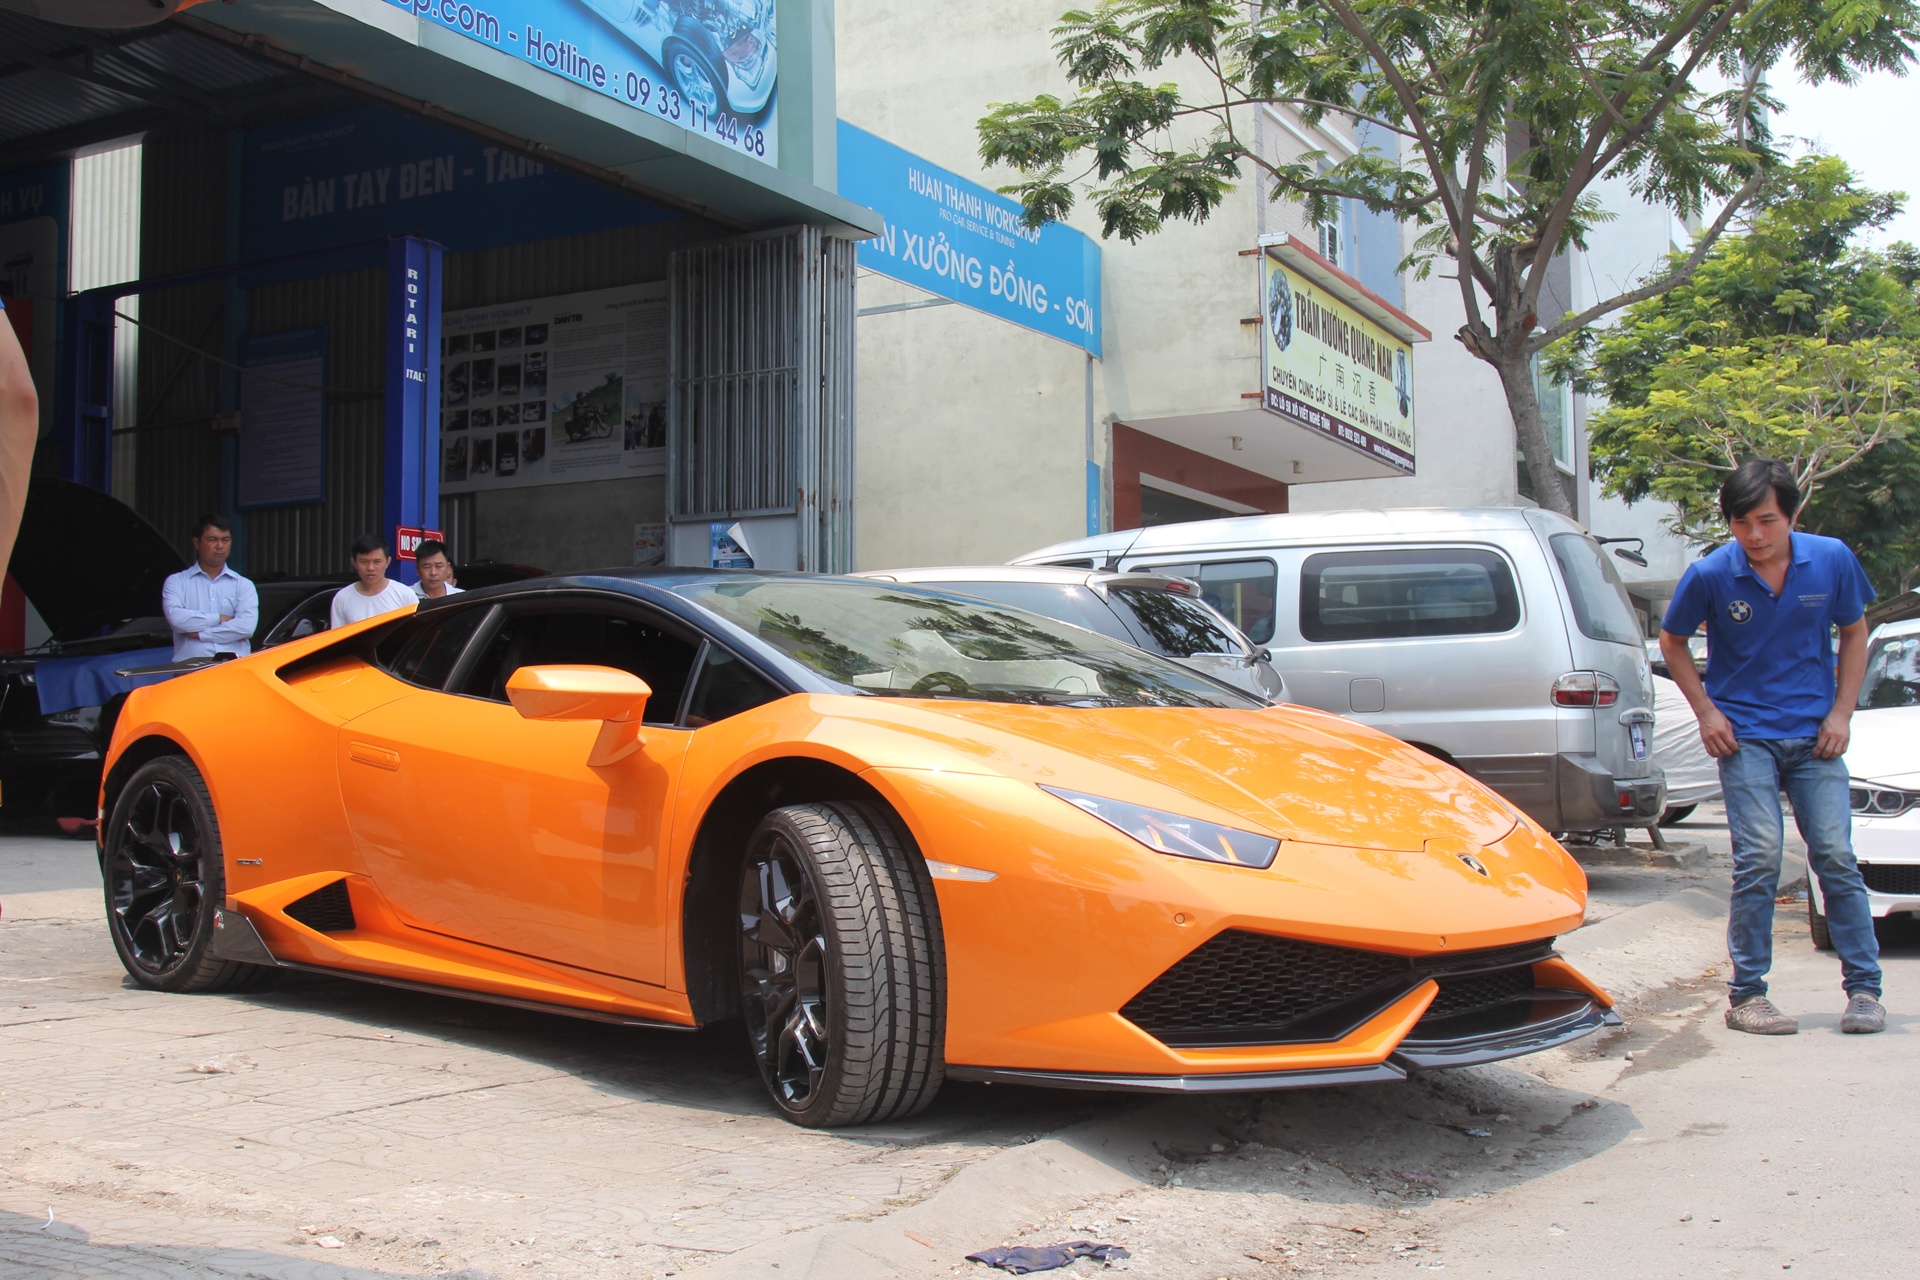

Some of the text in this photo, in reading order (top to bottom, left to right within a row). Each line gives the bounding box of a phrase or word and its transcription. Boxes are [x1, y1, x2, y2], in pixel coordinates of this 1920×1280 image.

[397, 0, 500, 44] p.com
[526, 24, 606, 88] Hotline
[626, 71, 651, 106] 09
[657, 84, 681, 120] 33
[688, 97, 708, 133] 11
[715, 111, 738, 146] 44
[743, 124, 765, 157] 68
[19, 184, 43, 213] VỤ
[282, 175, 335, 222] BÀN
[343, 167, 392, 210] TAY
[399, 155, 454, 200] ĐEN
[908, 167, 943, 203] HUAN
[945, 184, 982, 220] THANH
[939, 207, 952, 222] PRO
[953, 214, 965, 228] CAR
[966, 219, 989, 238] SERVICE
[995, 231, 1015, 249] TUNING
[902, 229, 983, 289] XƯỞNG
[989, 259, 1048, 314] ĐỒNG
[1065, 296, 1093, 335] SƠN
[406, 268, 418, 353] ROTARI
[1376, 341, 1393, 383] NAM
[1298, 378, 1314, 399] CUNG
[400, 535, 410, 551] NO
